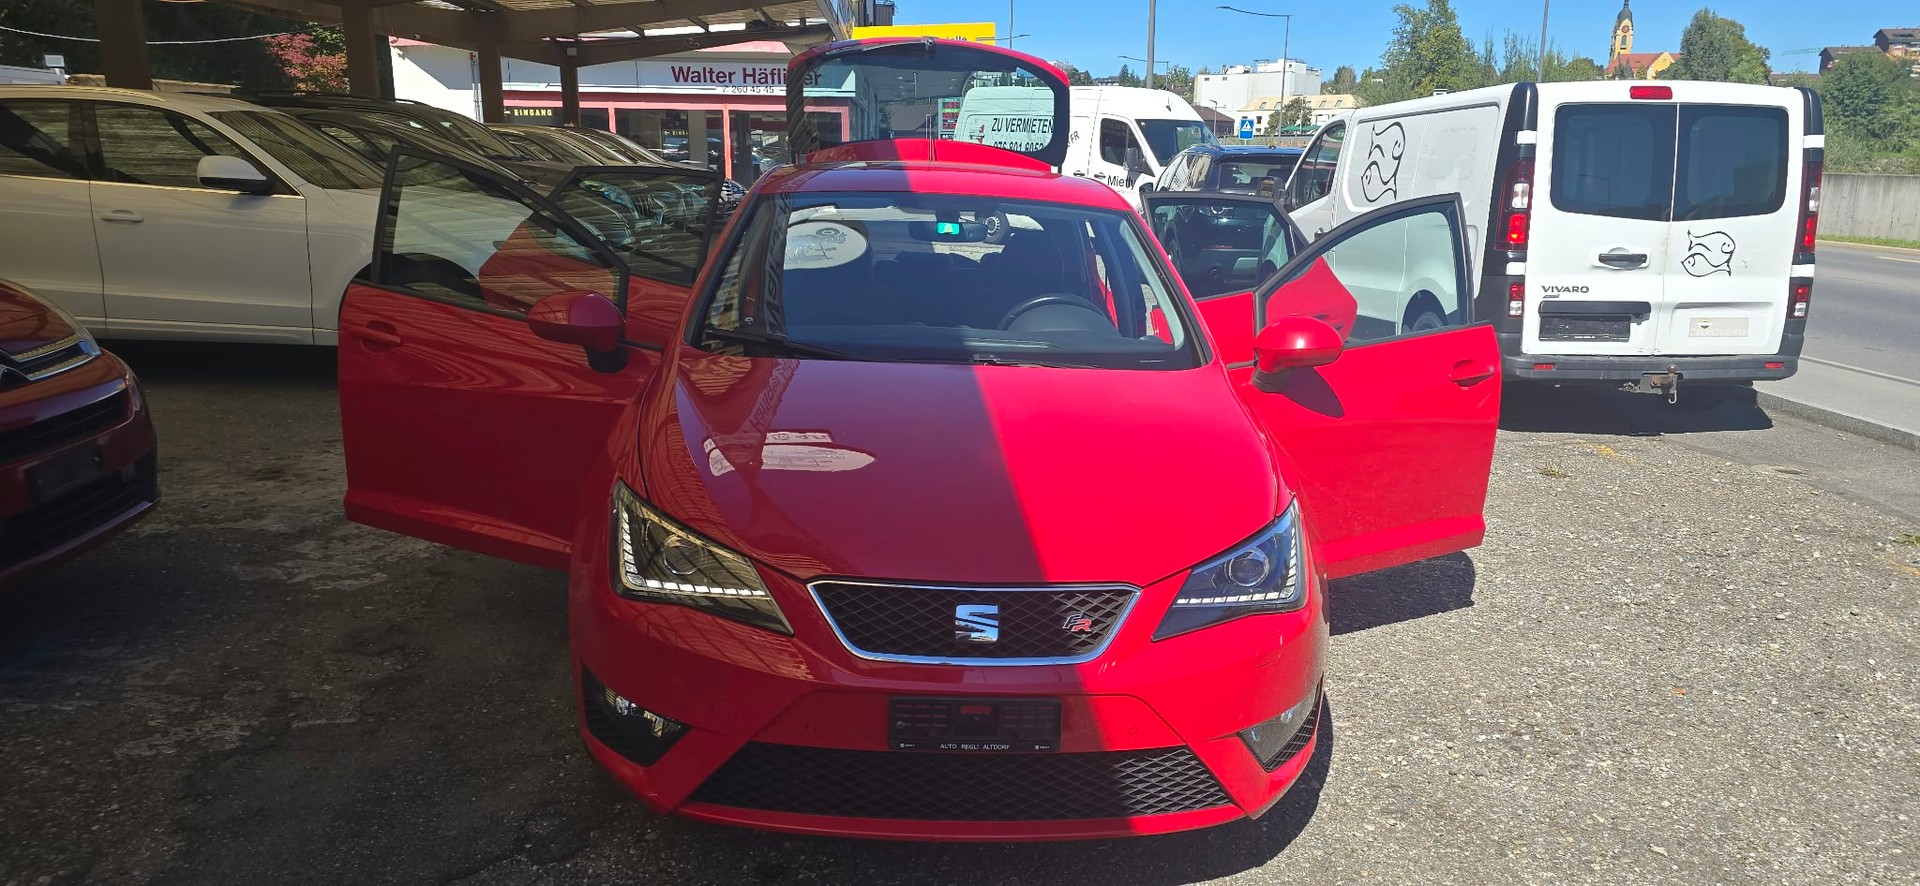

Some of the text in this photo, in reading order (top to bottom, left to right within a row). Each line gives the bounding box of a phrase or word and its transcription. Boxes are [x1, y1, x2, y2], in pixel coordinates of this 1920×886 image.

[671, 66, 822, 85] Walter Häflier
[991, 118, 1054, 133] ZU VERMIETEN
[1541, 285, 1590, 293] VIVARO
[1062, 613, 1092, 632] FR
